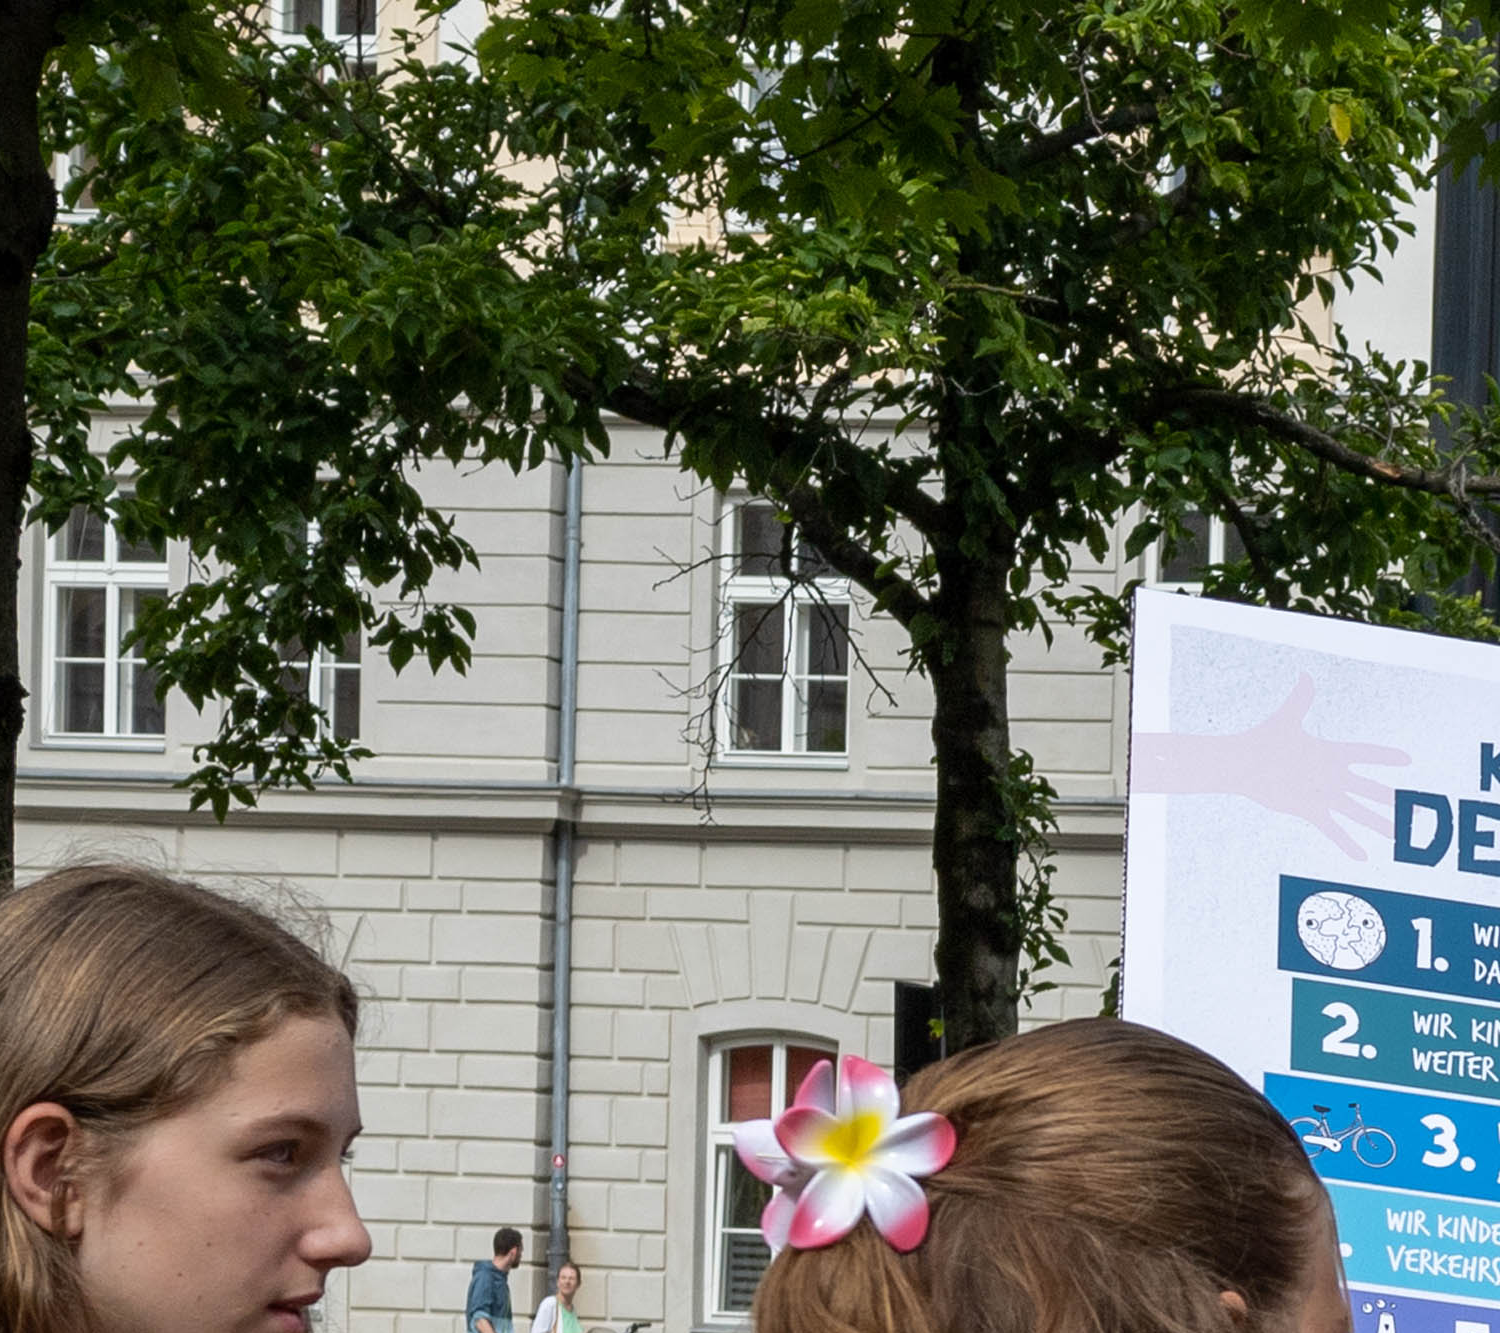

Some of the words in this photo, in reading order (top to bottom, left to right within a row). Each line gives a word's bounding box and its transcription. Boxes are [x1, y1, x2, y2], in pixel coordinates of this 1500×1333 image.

[1411, 917, 1449, 972] 1.
[1321, 1002, 1377, 1060] 2.
[1413, 1010, 1457, 1039] WIR
[1412, 1047, 1499, 1082] WEITER
[1419, 1113, 1477, 1173] 3.
[1386, 1207, 1431, 1237] WIR
